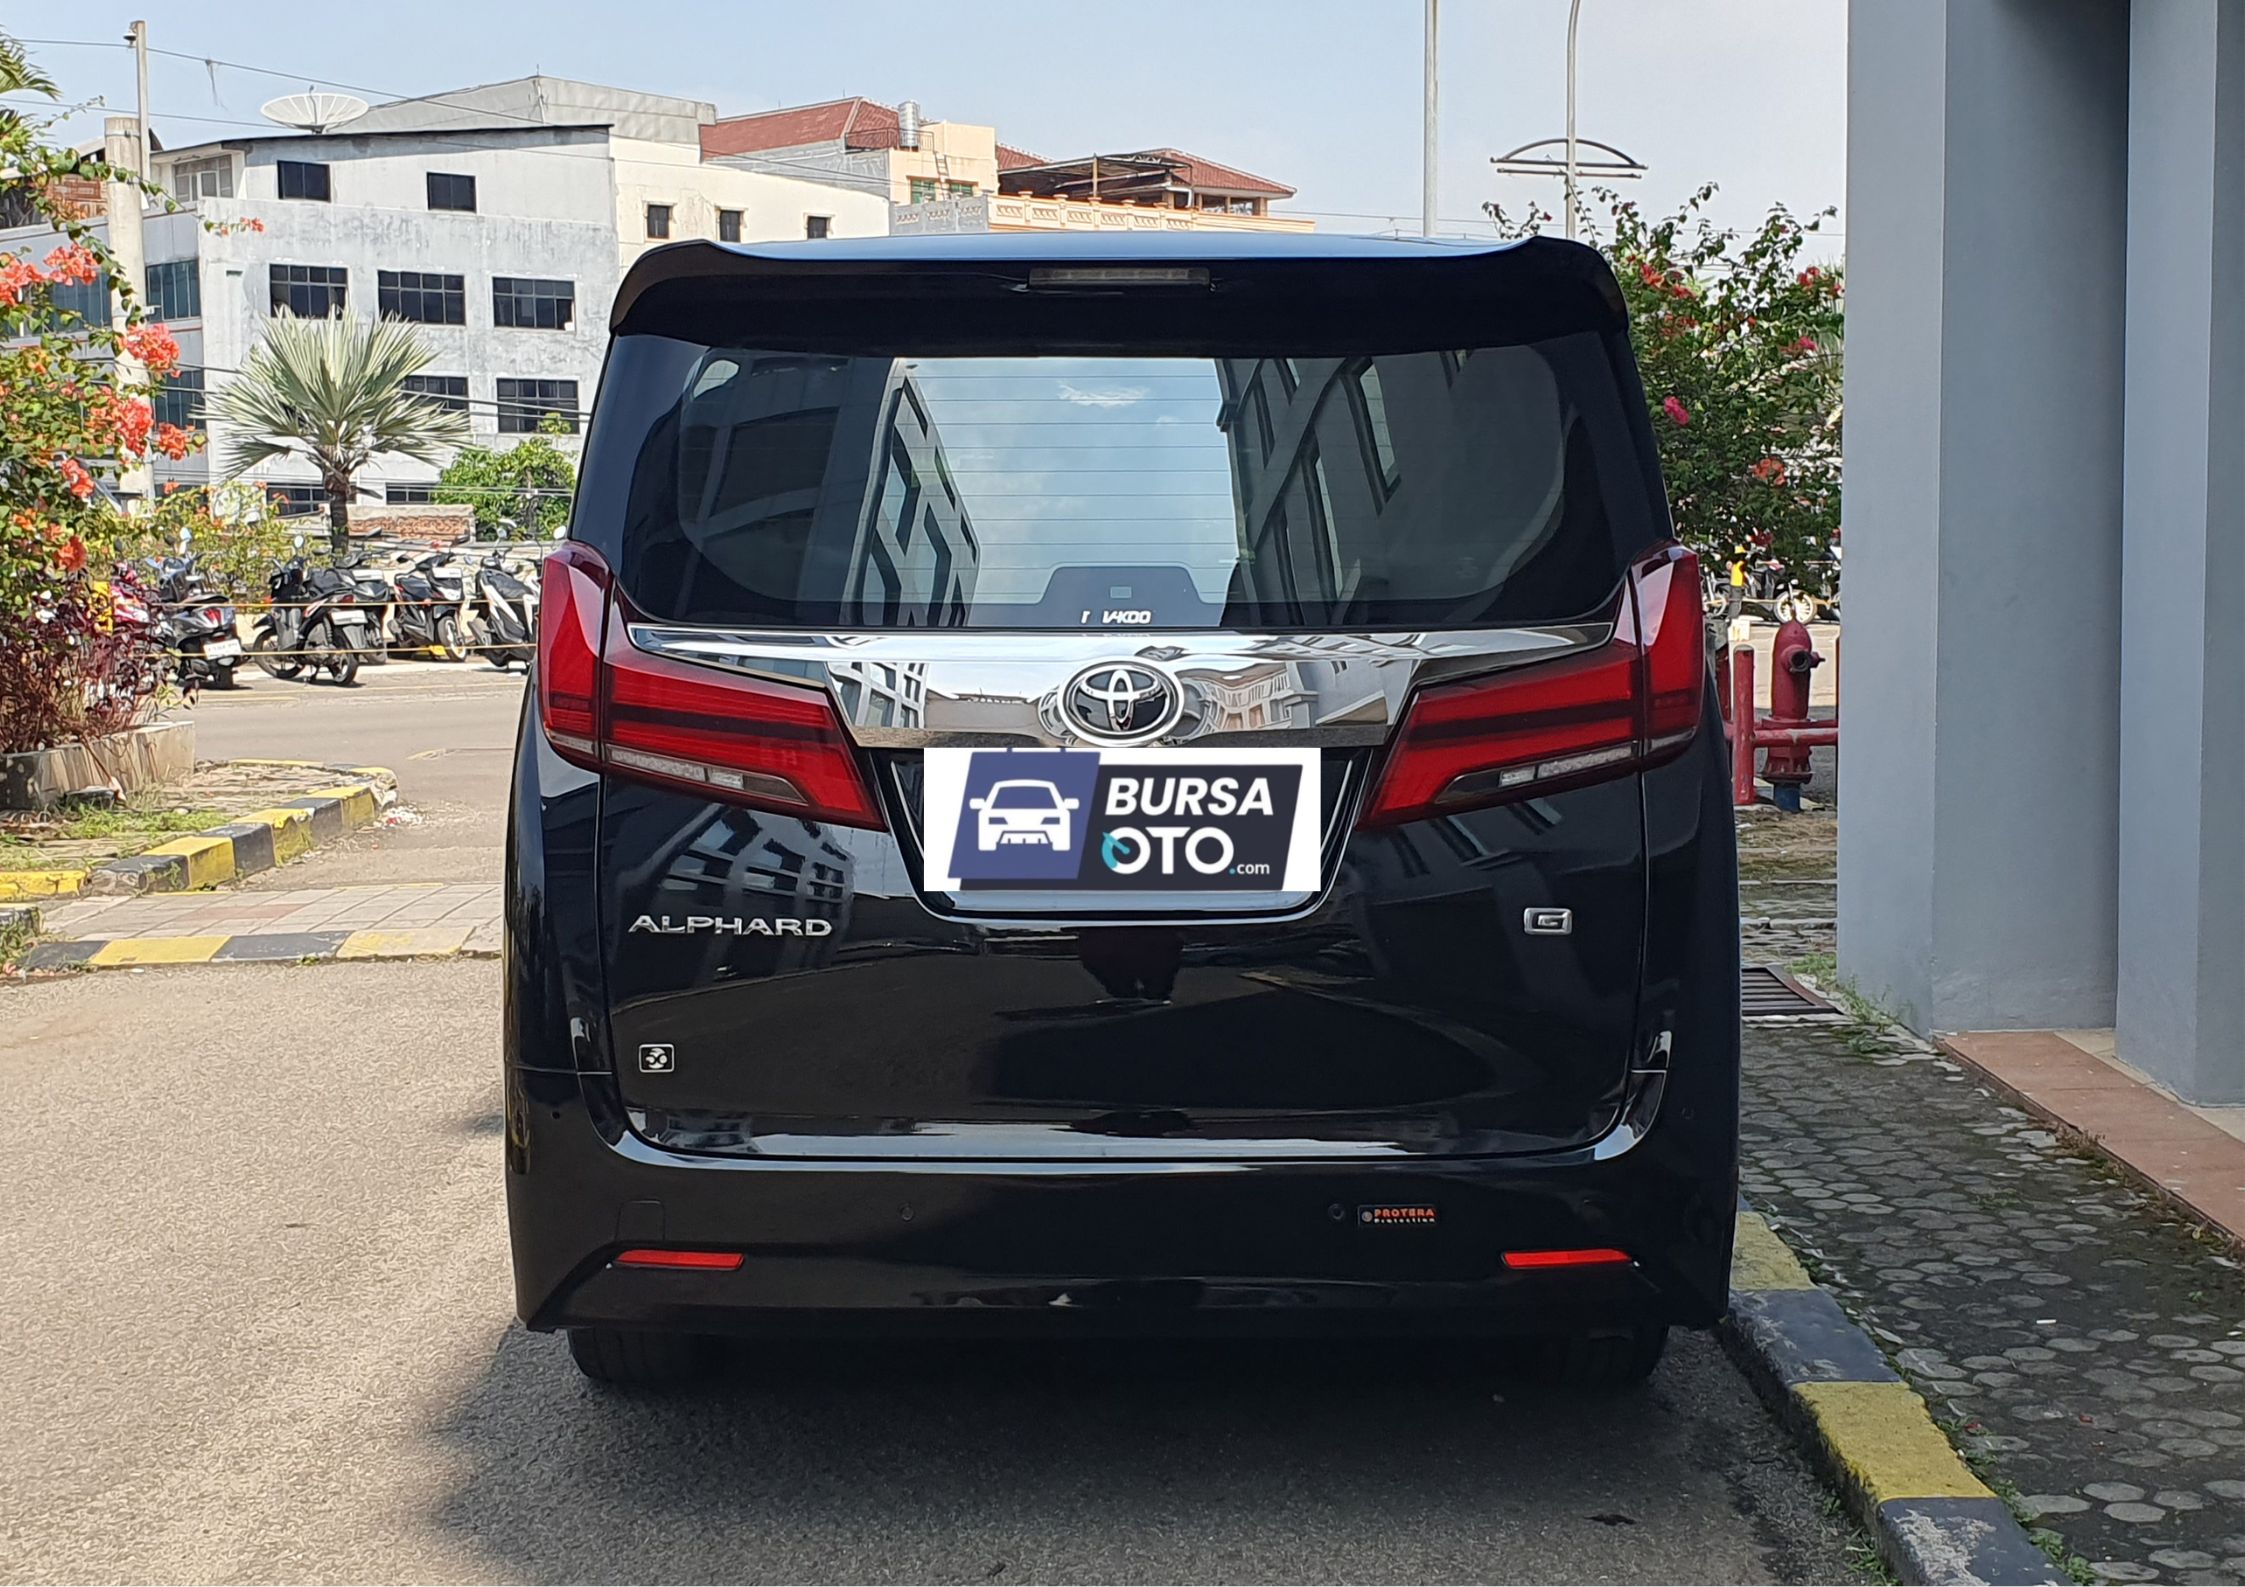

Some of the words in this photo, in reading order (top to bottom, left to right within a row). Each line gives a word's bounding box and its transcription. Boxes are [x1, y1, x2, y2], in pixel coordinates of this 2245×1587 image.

[628, 915, 833, 937] ALPHARD
[1528, 910, 1568, 931] G
[1374, 1208, 1435, 1217] PROTERA
